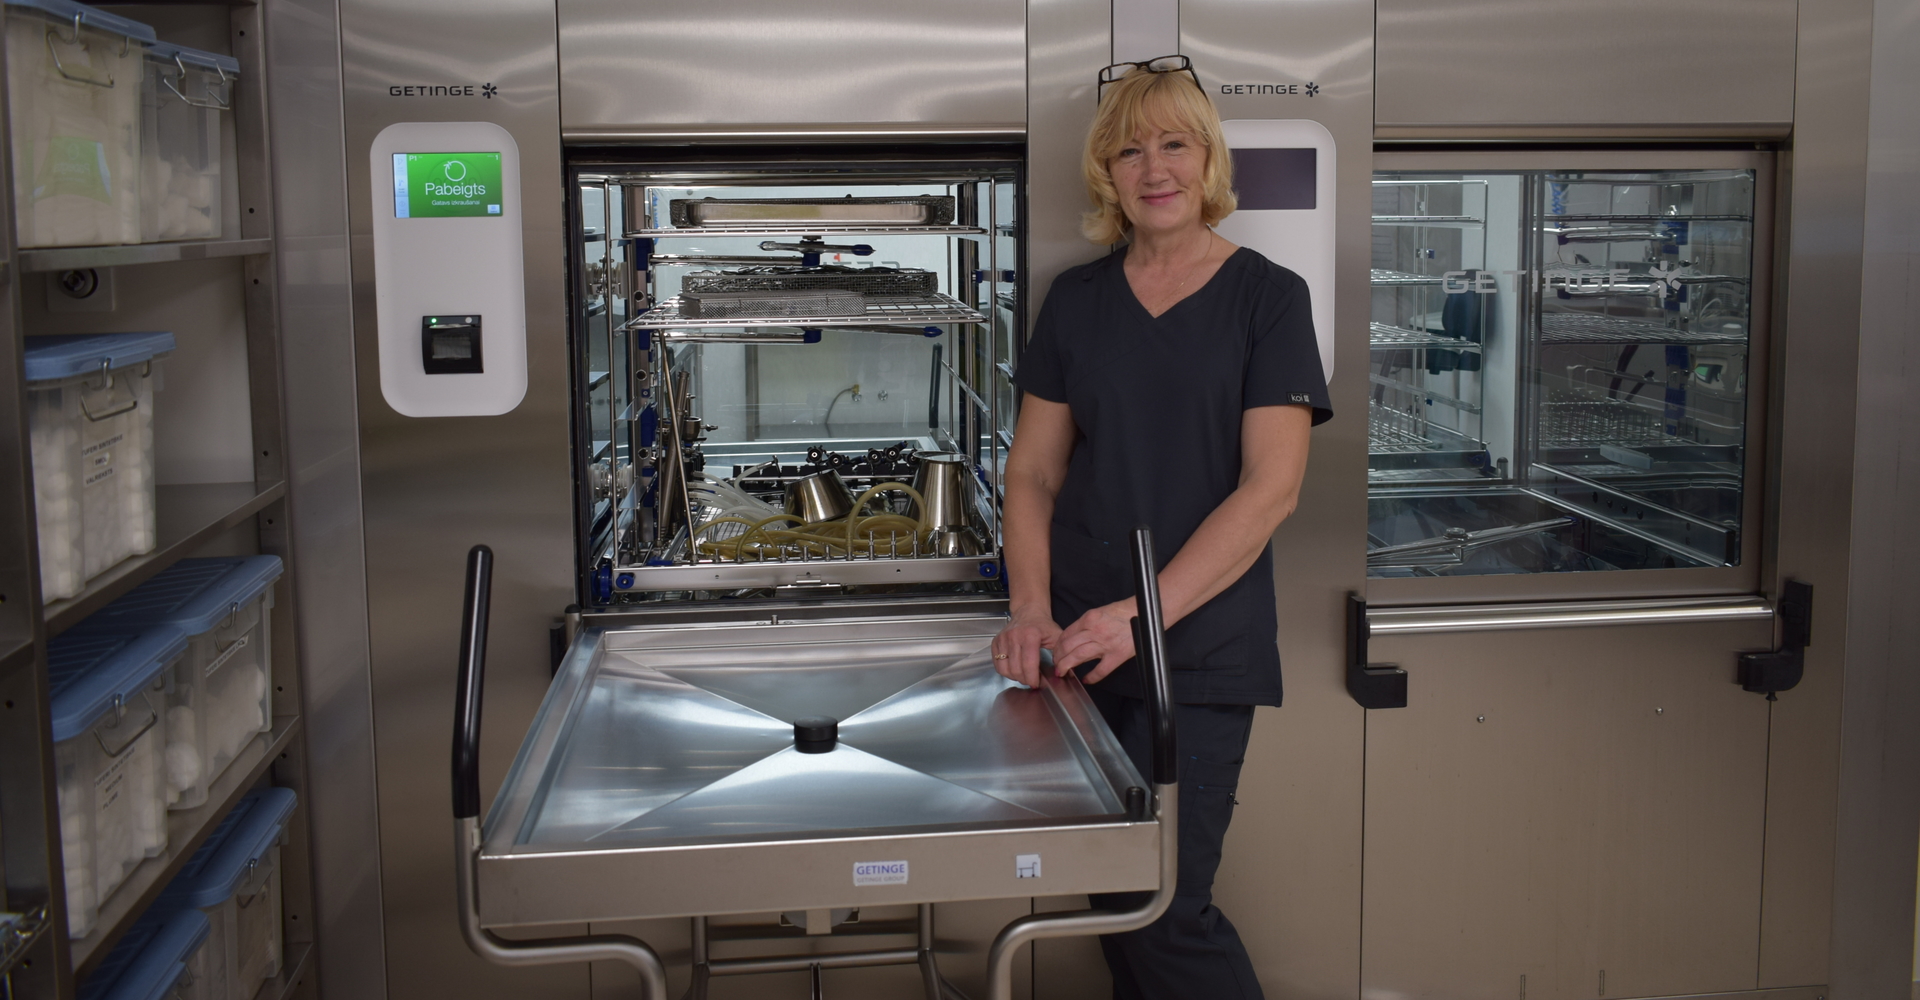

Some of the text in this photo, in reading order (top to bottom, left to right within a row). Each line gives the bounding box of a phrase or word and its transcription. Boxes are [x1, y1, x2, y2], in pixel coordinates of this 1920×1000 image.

[389, 85, 474, 97] GETINGE
[1221, 84, 1298, 95] GETINGE
[425, 182, 486, 198] Pabeigts
[1442, 268, 1631, 294] GETINGE
[1290, 393, 1304, 402] koi
[856, 864, 905, 875] GETINGE
